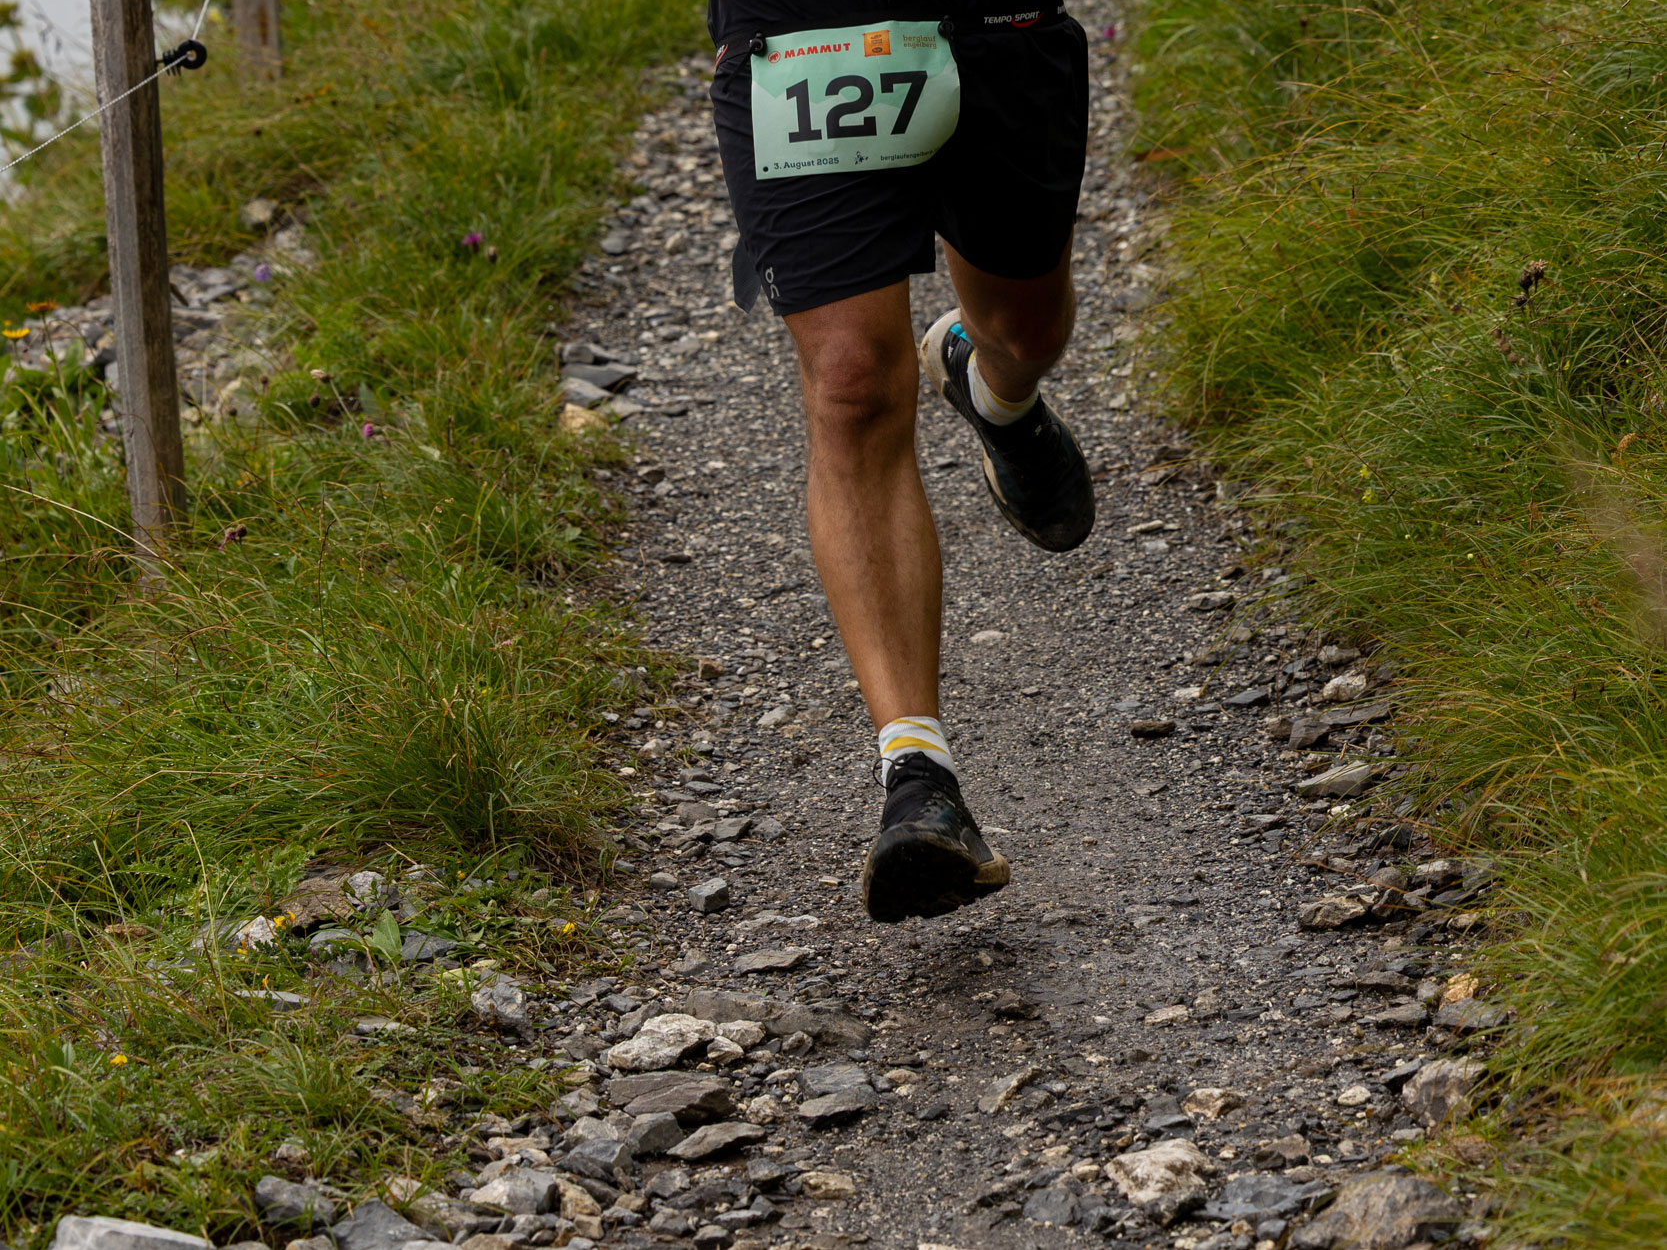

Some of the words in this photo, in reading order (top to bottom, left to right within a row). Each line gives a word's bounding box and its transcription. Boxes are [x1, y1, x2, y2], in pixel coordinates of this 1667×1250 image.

[983, 15, 1012, 24] TEMPO
[1014, 10, 1040, 22] SPORT
[902, 34, 936, 43] berglauf
[903, 41, 937, 49] engelberg
[784, 42, 851, 59] MAMMUT
[785, 70, 928, 143] 127
[773, 162, 782, 170] 3.
[783, 159, 815, 169] August
[816, 156, 840, 165] 2025
